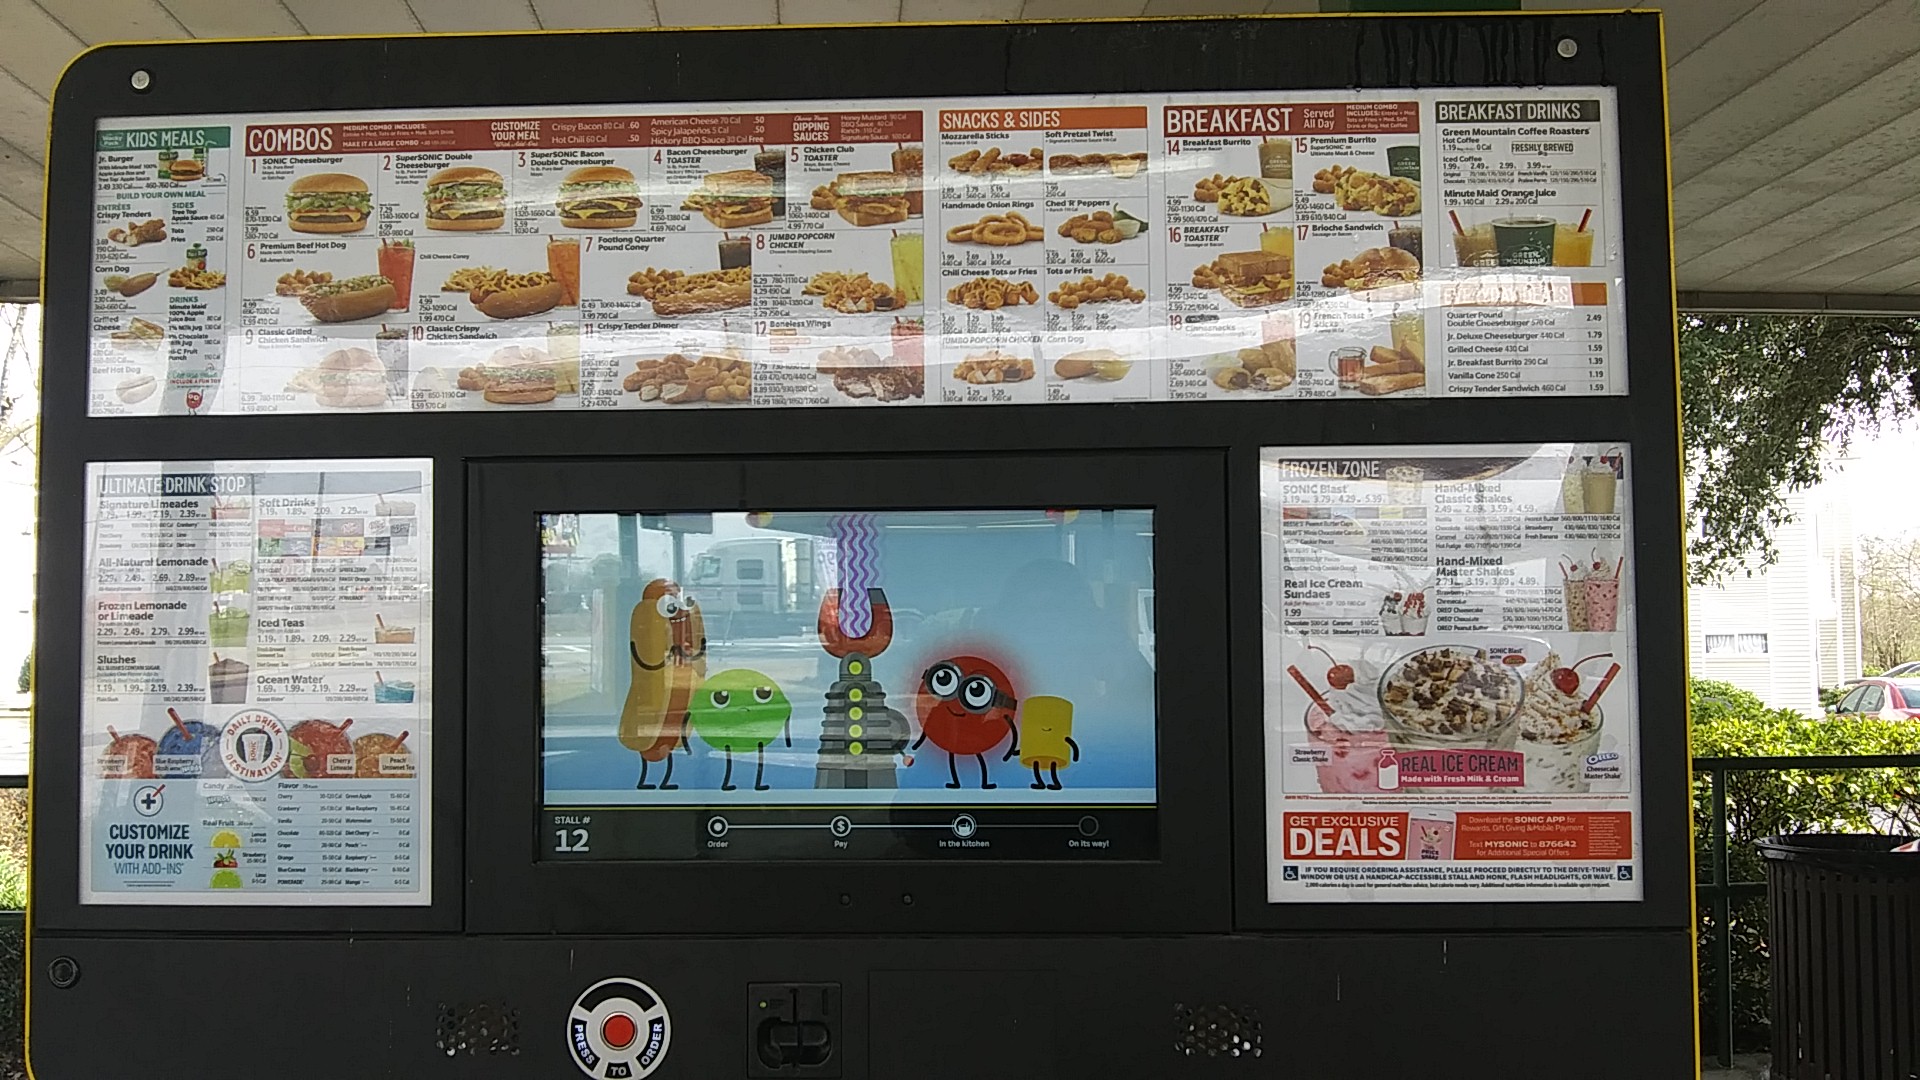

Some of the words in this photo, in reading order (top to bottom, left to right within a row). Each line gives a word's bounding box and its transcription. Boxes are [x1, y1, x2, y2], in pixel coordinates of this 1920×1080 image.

[1303, 108, 1335, 119] Served
[1438, 103, 1523, 120] BREAKFAST
[1527, 102, 1581, 120] DRINKS
[650, 118, 689, 126] American
[689, 117, 719, 125] Cheese
[942, 112, 1000, 129] SNACKS
[1003, 113, 1016, 128] &
[1019, 111, 1061, 127] SIDES
[1167, 107, 1294, 134] BREAKFAST
[1303, 119, 1316, 129] All
[1317, 119, 1335, 130] Day
[491, 121, 540, 131] CUSTOMIZE
[551, 122, 576, 132] Crispy
[577, 121, 603, 130] Bacon
[792, 121, 830, 132] DIPPING
[491, 131, 516, 141] YOUR
[517, 130, 540, 140] MEAL
[793, 131, 829, 141] SAUCES
[941, 132, 985, 140] Mozzarella
[985, 132, 1010, 140] Sticks
[1062, 130, 1091, 138] Pretzel
[1442, 128, 1470, 136] Green
[1472, 128, 1516, 136] Mountain
[1517, 127, 1548, 135] Coffee
[1549, 127, 1590, 135] Roasters
[125, 132, 158, 148] KIDS
[161, 130, 205, 147] MEALS
[249, 127, 334, 152] COMBOS
[1182, 139, 1221, 147] Breakfast
[1222, 138, 1252, 146] Burrito
[1310, 137, 1346, 145] Premium
[1348, 136, 1377, 144] Burrito
[804, 146, 835, 154] Chicken
[835, 145, 855, 154] Club
[1166, 139, 1181, 156] 14
[1294, 137, 1308, 153] 15
[1511, 143, 1542, 152] FRESHLY
[1543, 143, 1574, 152] BREWED
[530, 150, 579, 159] SuperSONIC
[580, 150, 605, 158] Bacon
[653, 149, 662, 165] 4
[692, 148, 748, 156] Cheeseburger
[790, 147, 799, 163] 5
[262, 157, 287, 165] SONIC
[289, 156, 343, 165] Cheeseburger
[383, 154, 391, 171] 2
[395, 154, 443, 162] SuperSONIC
[444, 153, 473, 161] Double
[518, 151, 526, 168] 3
[530, 158, 559, 167] Double
[560, 158, 615, 166] Cheeseburger
[804, 154, 838, 162] TOASTER
[395, 161, 450, 170] Cheeseburger
[163, 191, 184, 199] OWN
[185, 190, 206, 198] MEAL
[1444, 190, 1476, 198] Minute
[1476, 189, 1499, 197] Maid
[1501, 189, 1535, 199] Orange
[1535, 189, 1557, 198] Juice
[96, 212, 120, 220] Crispy
[121, 210, 152, 218] Tenders
[1183, 225, 1229, 233] BREAKFAST
[769, 233, 796, 242] JUMBO
[1168, 226, 1181, 243] 16
[1184, 234, 1220, 242] TOASTER
[585, 236, 593, 253] 7
[598, 236, 634, 245] Footlong
[756, 234, 765, 250] 8
[769, 241, 805, 249] CHICKEN
[247, 243, 256, 259] 6
[260, 242, 295, 251] Premium
[296, 242, 312, 250] Beef
[314, 241, 327, 249] Hot
[327, 241, 347, 251] Dog
[1447, 345, 1474, 353] Grilled
[1281, 462, 1339, 478] FROZEN
[1341, 460, 1380, 477] ZONE
[100, 477, 162, 494] ULTIMATE
[165, 476, 205, 493] DRINK
[210, 476, 246, 493] STOP
[1436, 556, 1503, 566] Hand-Mixed
[1284, 580, 1308, 589] Real
[1310, 579, 1325, 588] Ice
[1327, 579, 1363, 588] Cream
[1284, 590, 1331, 599] Sundaes
[98, 601, 132, 610] Frozen
[134, 601, 187, 610] Lemonade
[98, 613, 109, 621] or
[110, 612, 154, 621] Limeade
[1284, 609, 1302, 617] 1.99
[257, 619, 280, 628] Iced
[281, 619, 305, 628] Teas
[97, 655, 137, 664] Slushes
[257, 675, 291, 684] Ocean
[292, 675, 324, 684] Water
[227, 715, 251, 737] DAILY
[255, 714, 283, 736] DRINK
[224, 753, 282, 778] DESTINATION
[1401, 756, 1437, 773] REAL
[1442, 754, 1464, 772] ICE
[1468, 754, 1518, 772] CREAM
[554, 816, 581, 825] STALL
[582, 816, 591, 824] #
[1289, 816, 1317, 827] GET
[1321, 816, 1399, 827] EXCLUSIVE
[1514, 816, 1545, 824] SONIC
[109, 824, 190, 840] CUSTOMIZE
[555, 829, 590, 852] 12
[707, 840, 728, 848] Order
[834, 840, 848, 850] Pay
[961, 840, 990, 848] kitchen
[1091, 840, 1110, 849] way!
[1290, 828, 1401, 856] DEALS
[105, 844, 145, 860] YOUR
[148, 844, 194, 860] DRINK
[114, 862, 140, 875] WITH
[141, 862, 183, 875] ADD-INS
[573, 1024, 595, 1066] PRESS
[640, 1023, 663, 1066] ORDER
[610, 1066, 627, 1076] TO
